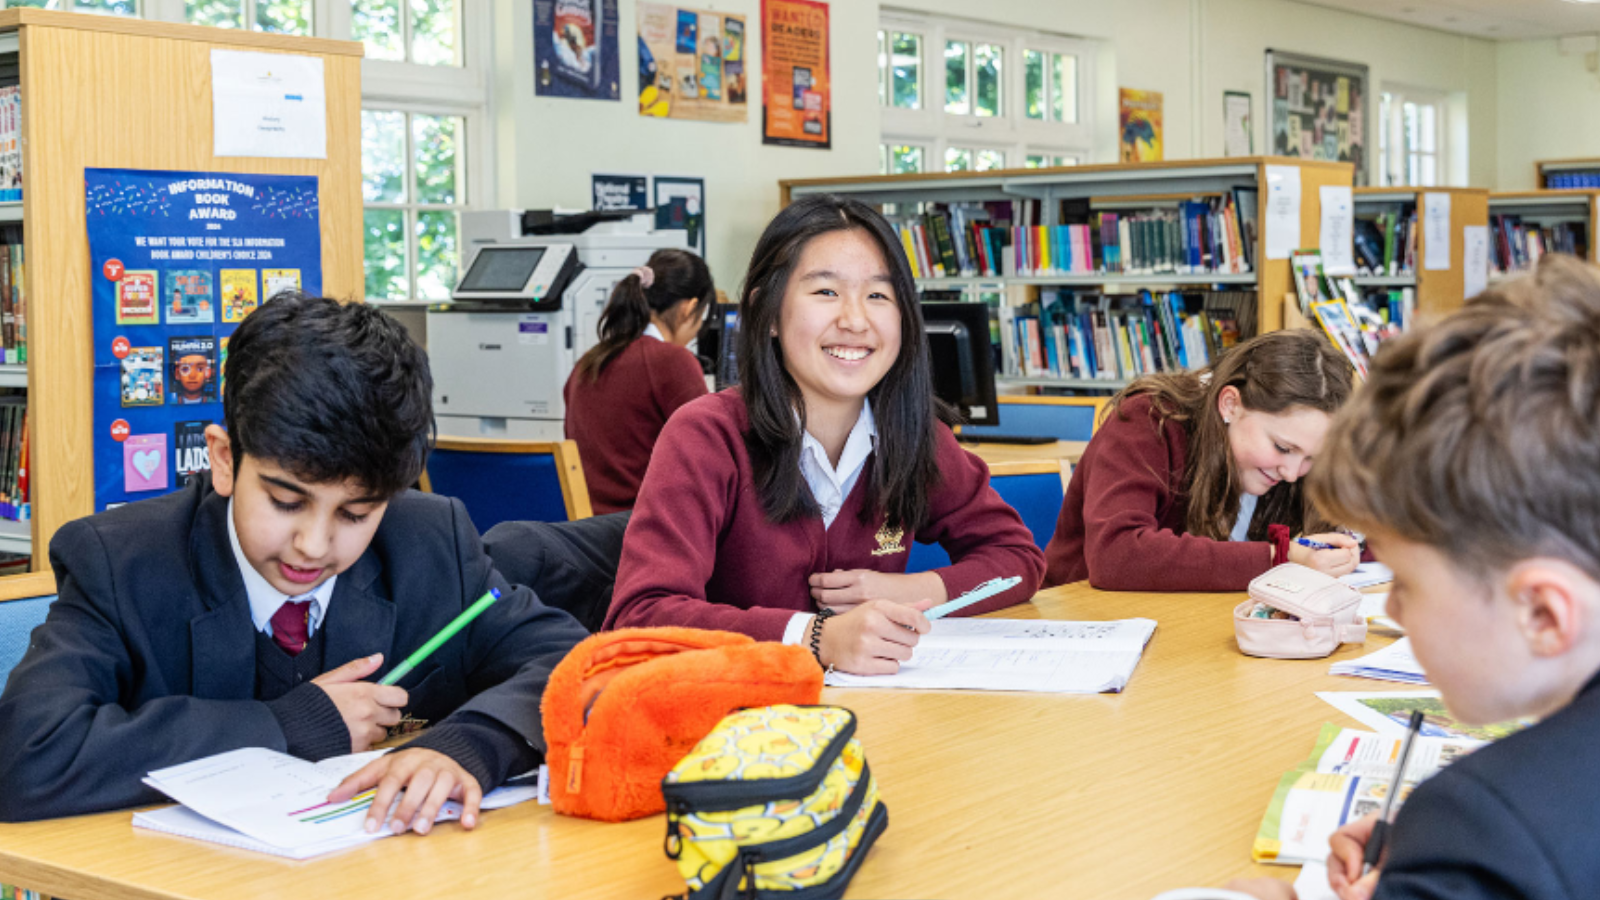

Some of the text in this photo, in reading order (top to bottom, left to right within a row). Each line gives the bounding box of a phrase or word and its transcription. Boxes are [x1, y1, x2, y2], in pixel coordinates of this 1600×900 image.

[771, 22, 820, 39] READERS
[168, 178, 254, 198] INFORMATION
[195, 193, 229, 205] BOOK
[189, 207, 236, 220] AWARD
[135, 236, 147, 246] WE
[148, 236, 167, 246] WANT
[168, 236, 186, 246] YOUR
[187, 236, 204, 247] VOTE
[205, 237, 217, 247] FOR
[218, 237, 231, 247] THE
[244, 238, 285, 247] INFORMATION
[151, 250, 170, 260] BOOK
[171, 250, 195, 260] AWARD
[195, 250, 232, 260] CHILDREN'S
[233, 250, 256, 260] CHOICE
[171, 341, 214, 351] HUMAN 2.0
[175, 446, 211, 473] LADS
